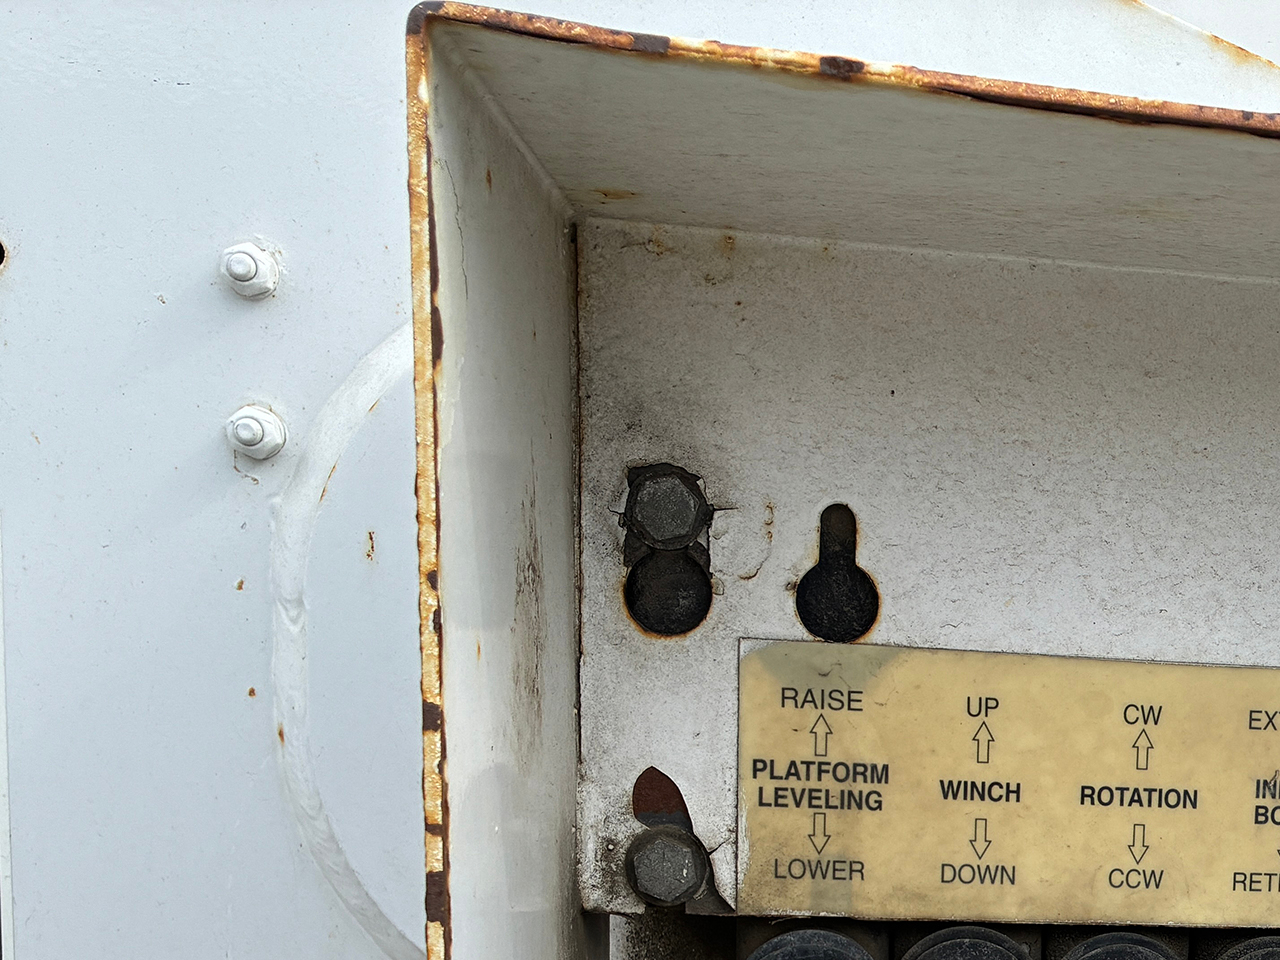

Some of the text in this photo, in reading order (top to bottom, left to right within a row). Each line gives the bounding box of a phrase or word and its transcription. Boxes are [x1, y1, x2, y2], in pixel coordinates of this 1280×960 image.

[780, 687, 864, 712] RAISE
[966, 697, 999, 718] UP
[1123, 704, 1162, 726] CW
[752, 759, 889, 785] PLATFORM
[758, 786, 883, 811] LEVELING
[940, 779, 1021, 803] WINCH
[1080, 785, 1198, 809] ROTATION
[773, 858, 865, 881] LOWER
[940, 863, 1016, 886] DOWN
[1108, 868, 1164, 889] CCW
